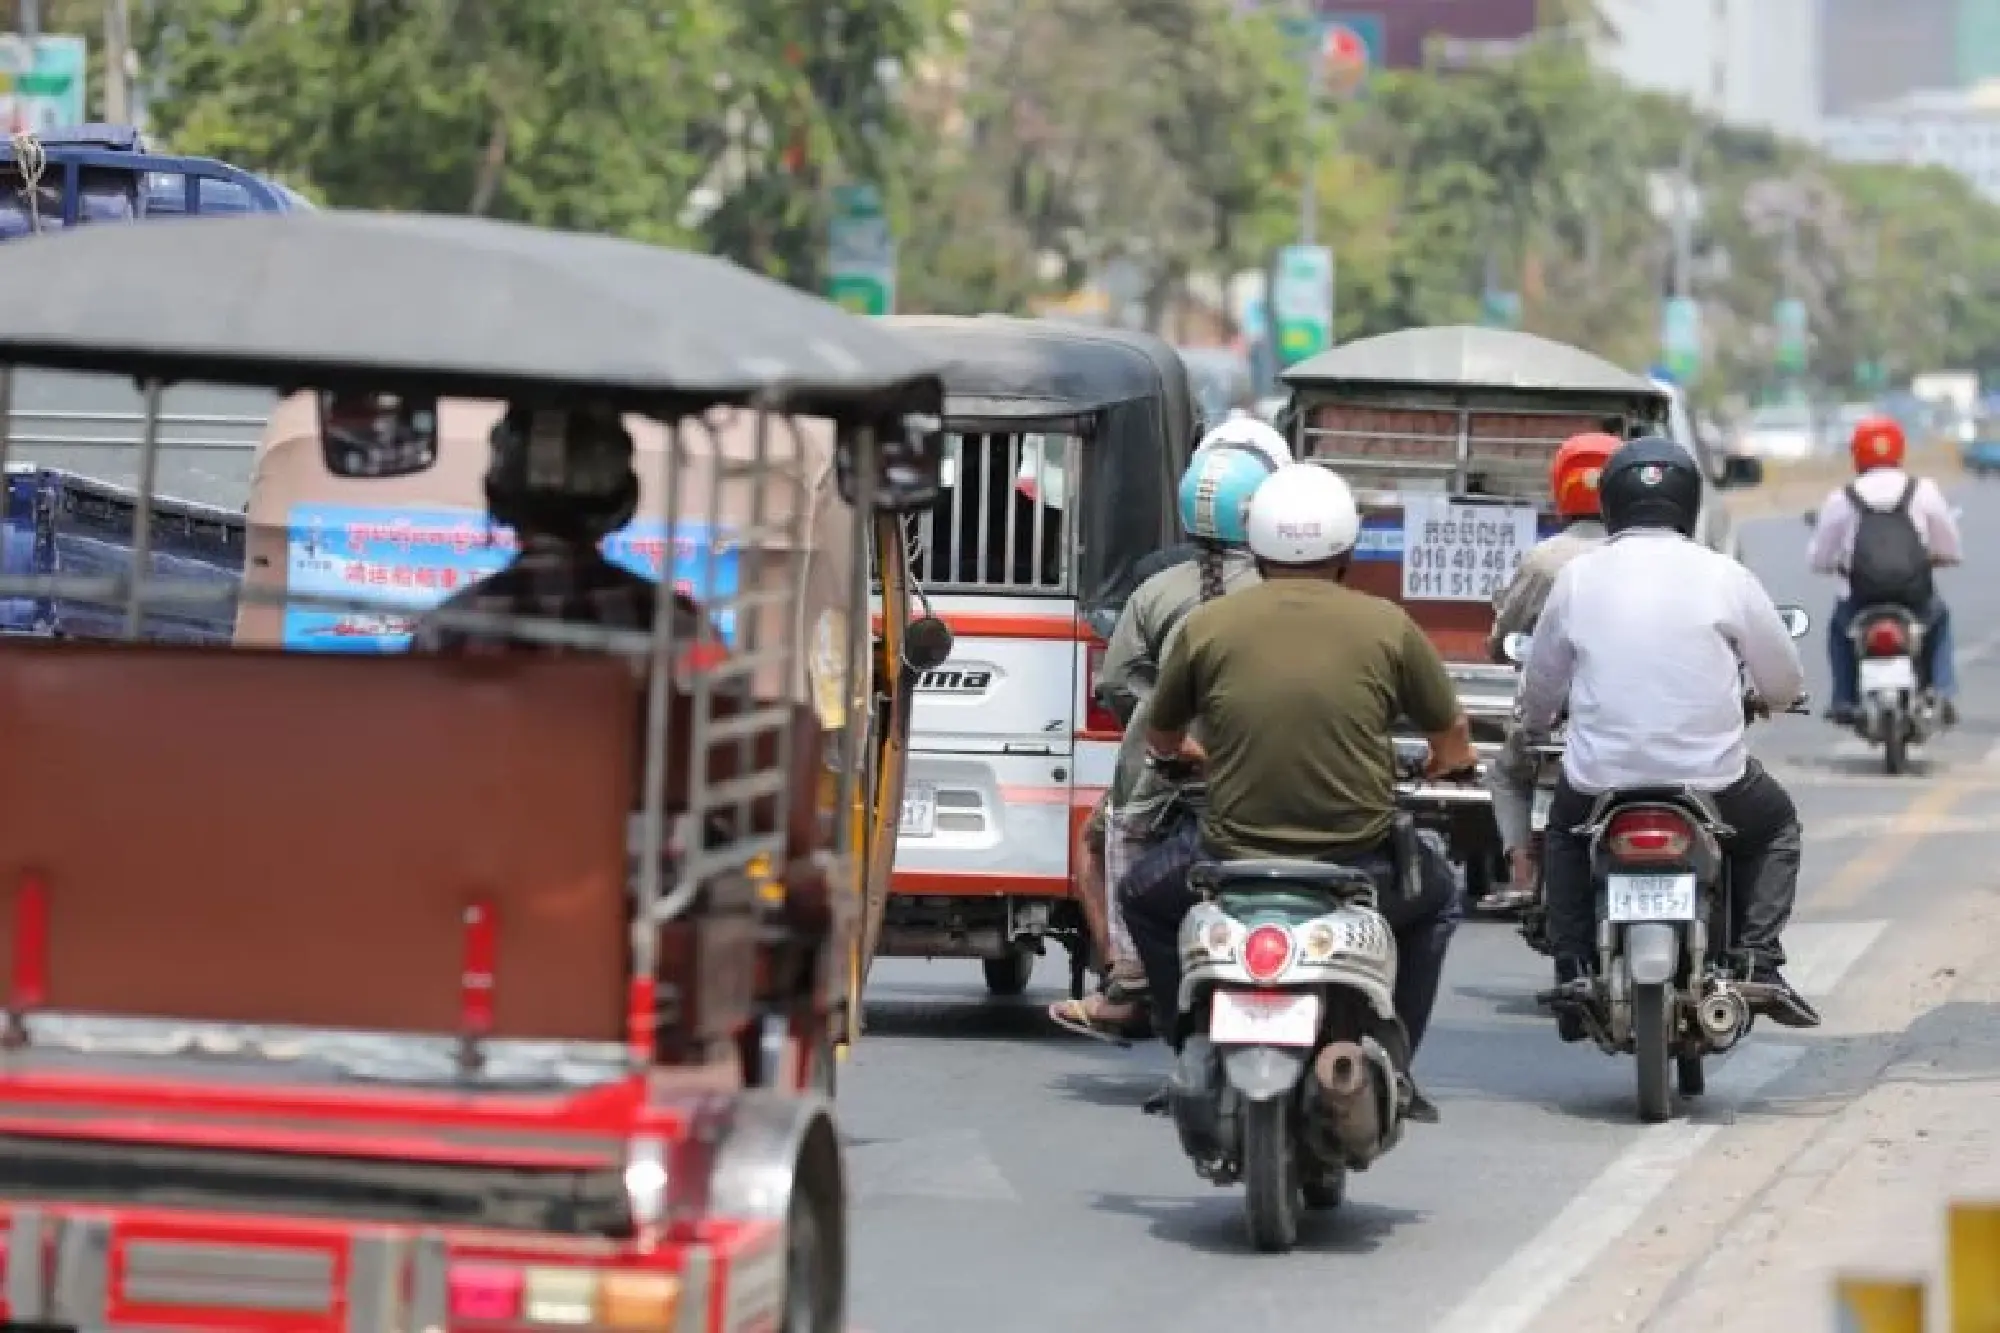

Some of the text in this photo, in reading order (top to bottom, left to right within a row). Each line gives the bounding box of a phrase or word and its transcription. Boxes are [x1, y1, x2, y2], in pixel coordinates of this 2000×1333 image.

[1410, 546, 1446, 568] 016
[1451, 548, 1475, 569] 49
[1409, 573, 1442, 595] 011
